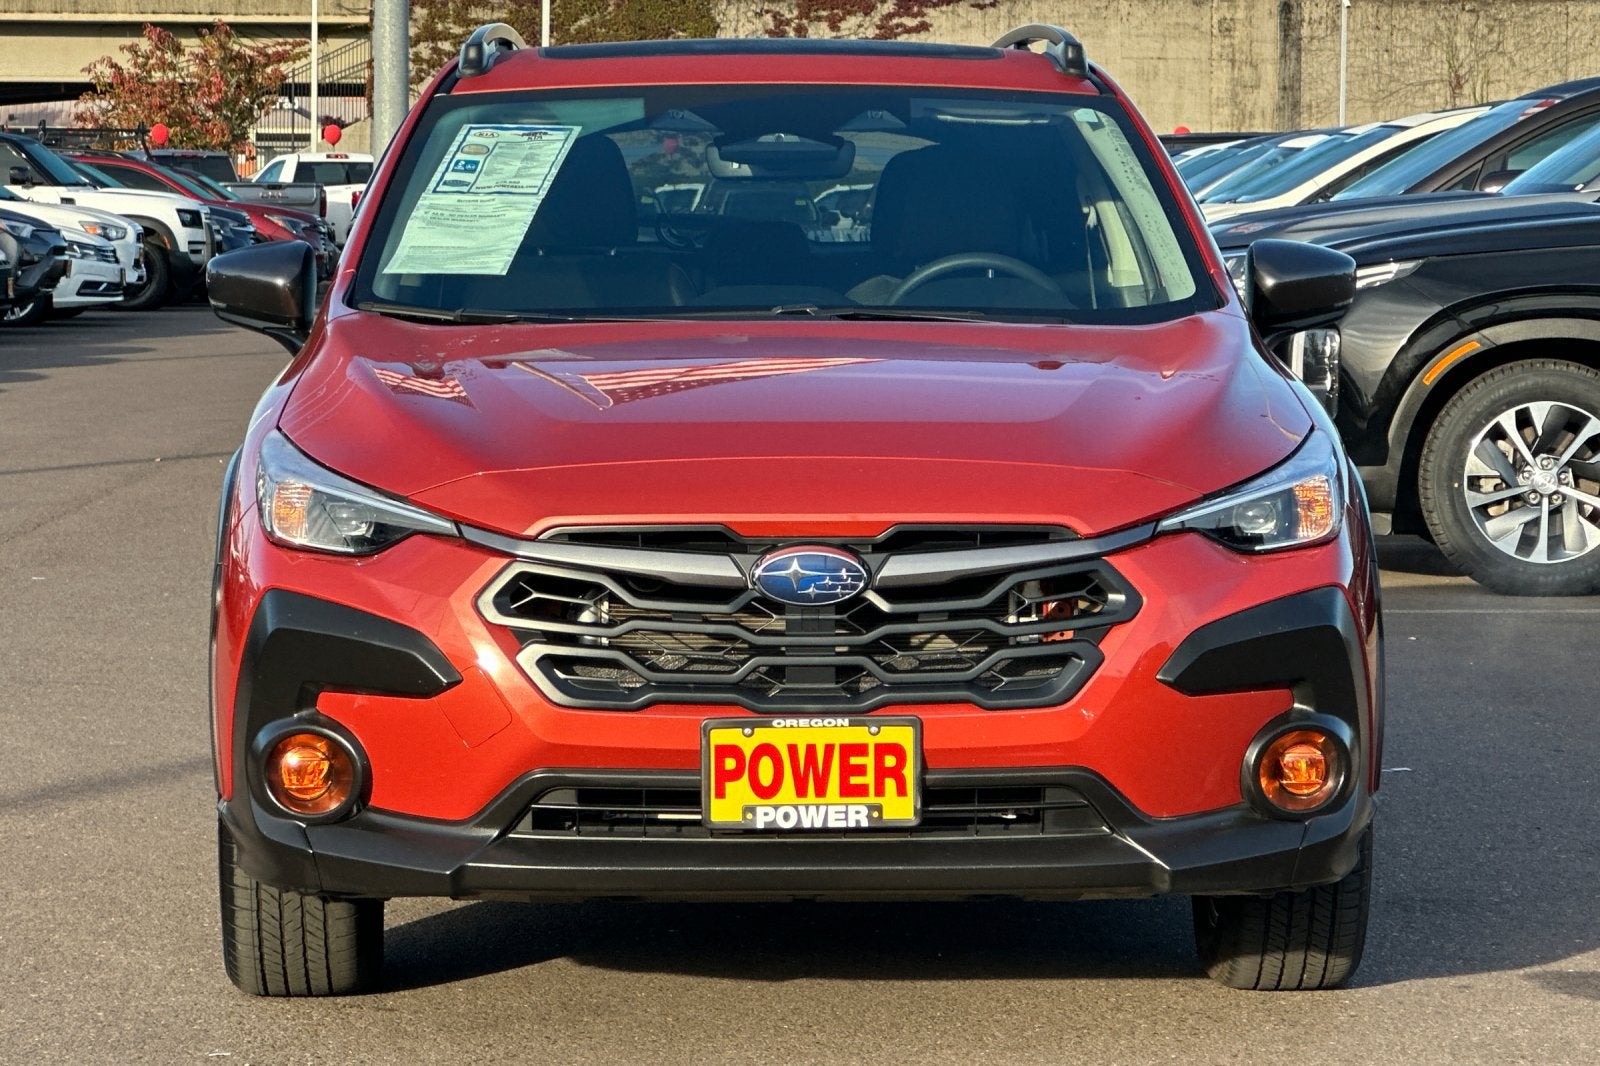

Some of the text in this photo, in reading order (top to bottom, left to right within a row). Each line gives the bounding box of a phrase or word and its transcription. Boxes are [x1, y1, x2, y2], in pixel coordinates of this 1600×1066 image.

[772, 718, 849, 727] OREGON
[714, 743, 908, 800] POWER
[756, 805, 868, 828] POWER
